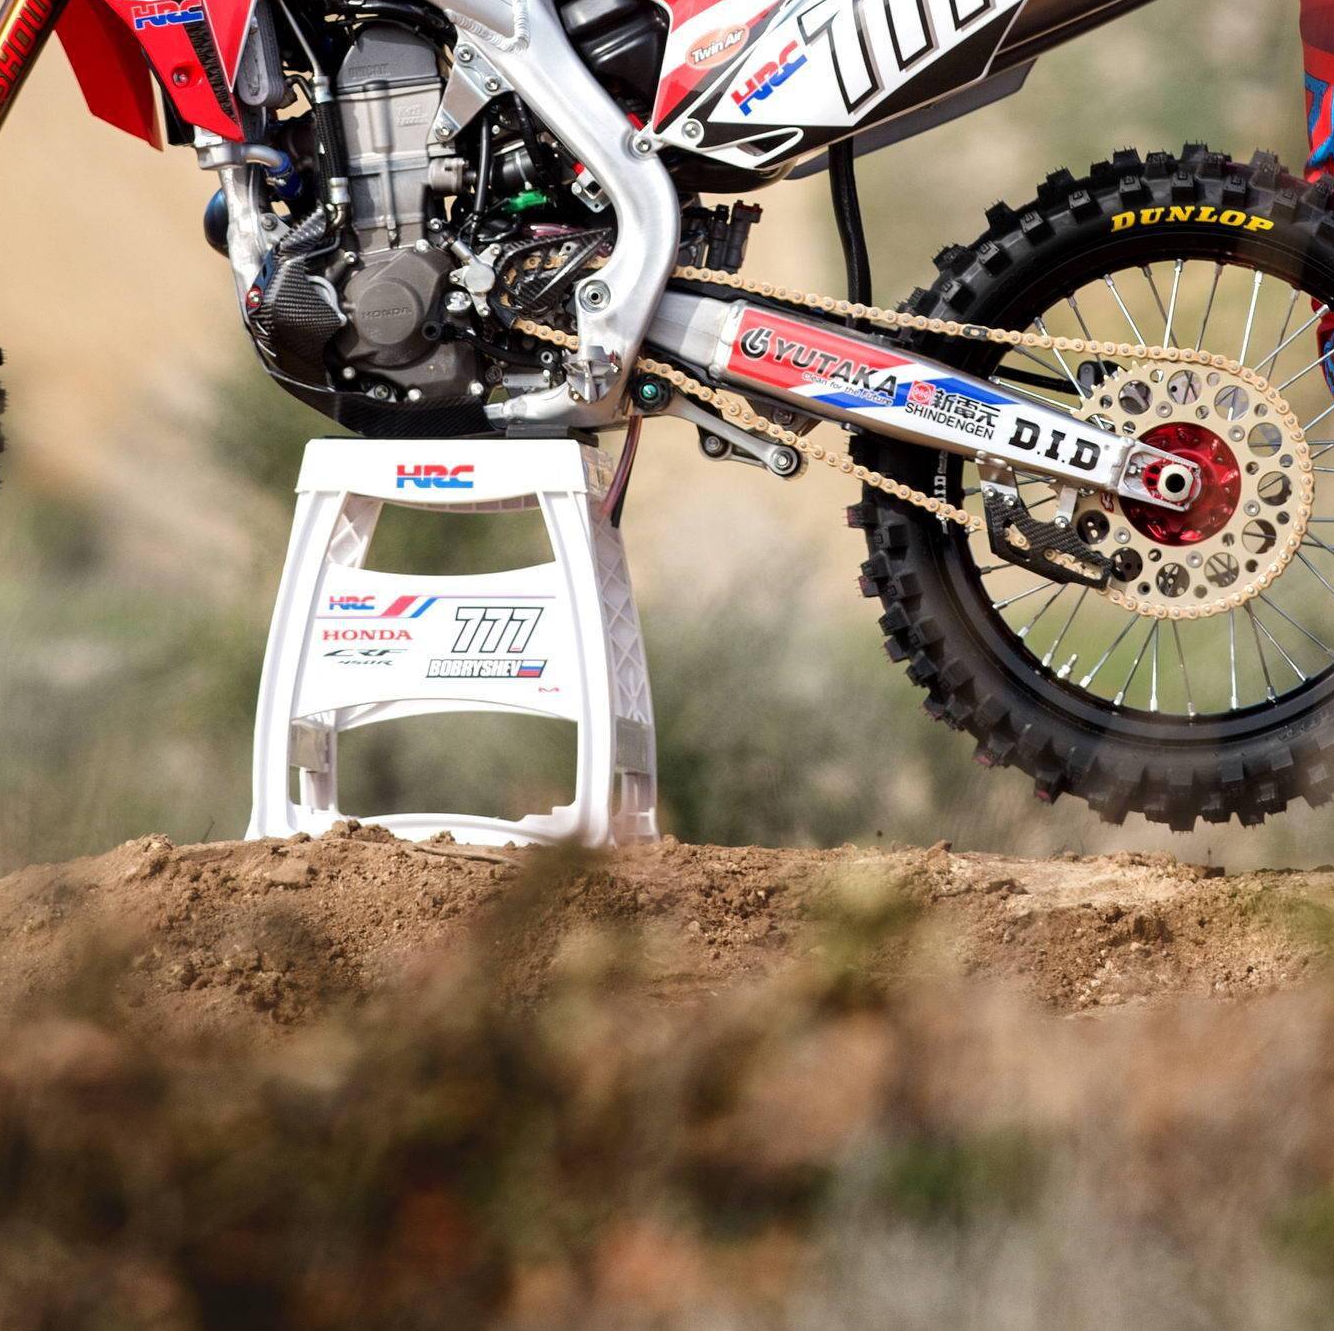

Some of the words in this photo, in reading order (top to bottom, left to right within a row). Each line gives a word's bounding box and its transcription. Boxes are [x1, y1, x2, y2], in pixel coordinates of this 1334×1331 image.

[131, 0, 205, 30] HRC
[691, 41, 724, 64] Twin
[725, 29, 746, 50] Air
[731, 40, 808, 117] HRC
[1111, 205, 1275, 233] DUNLOP
[775, 337, 898, 398] YUTAKA
[830, 379, 843, 390] for
[845, 386, 859, 397] the
[861, 390, 894, 407] Future
[905, 403, 995, 441] SHINDENGEN
[396, 465, 474, 488] HRC
[329, 596, 376, 610] HRC
[322, 629, 413, 640] HONDA
[451, 606, 545, 653] 777
[425, 659, 523, 678] BOBRYSHEV
